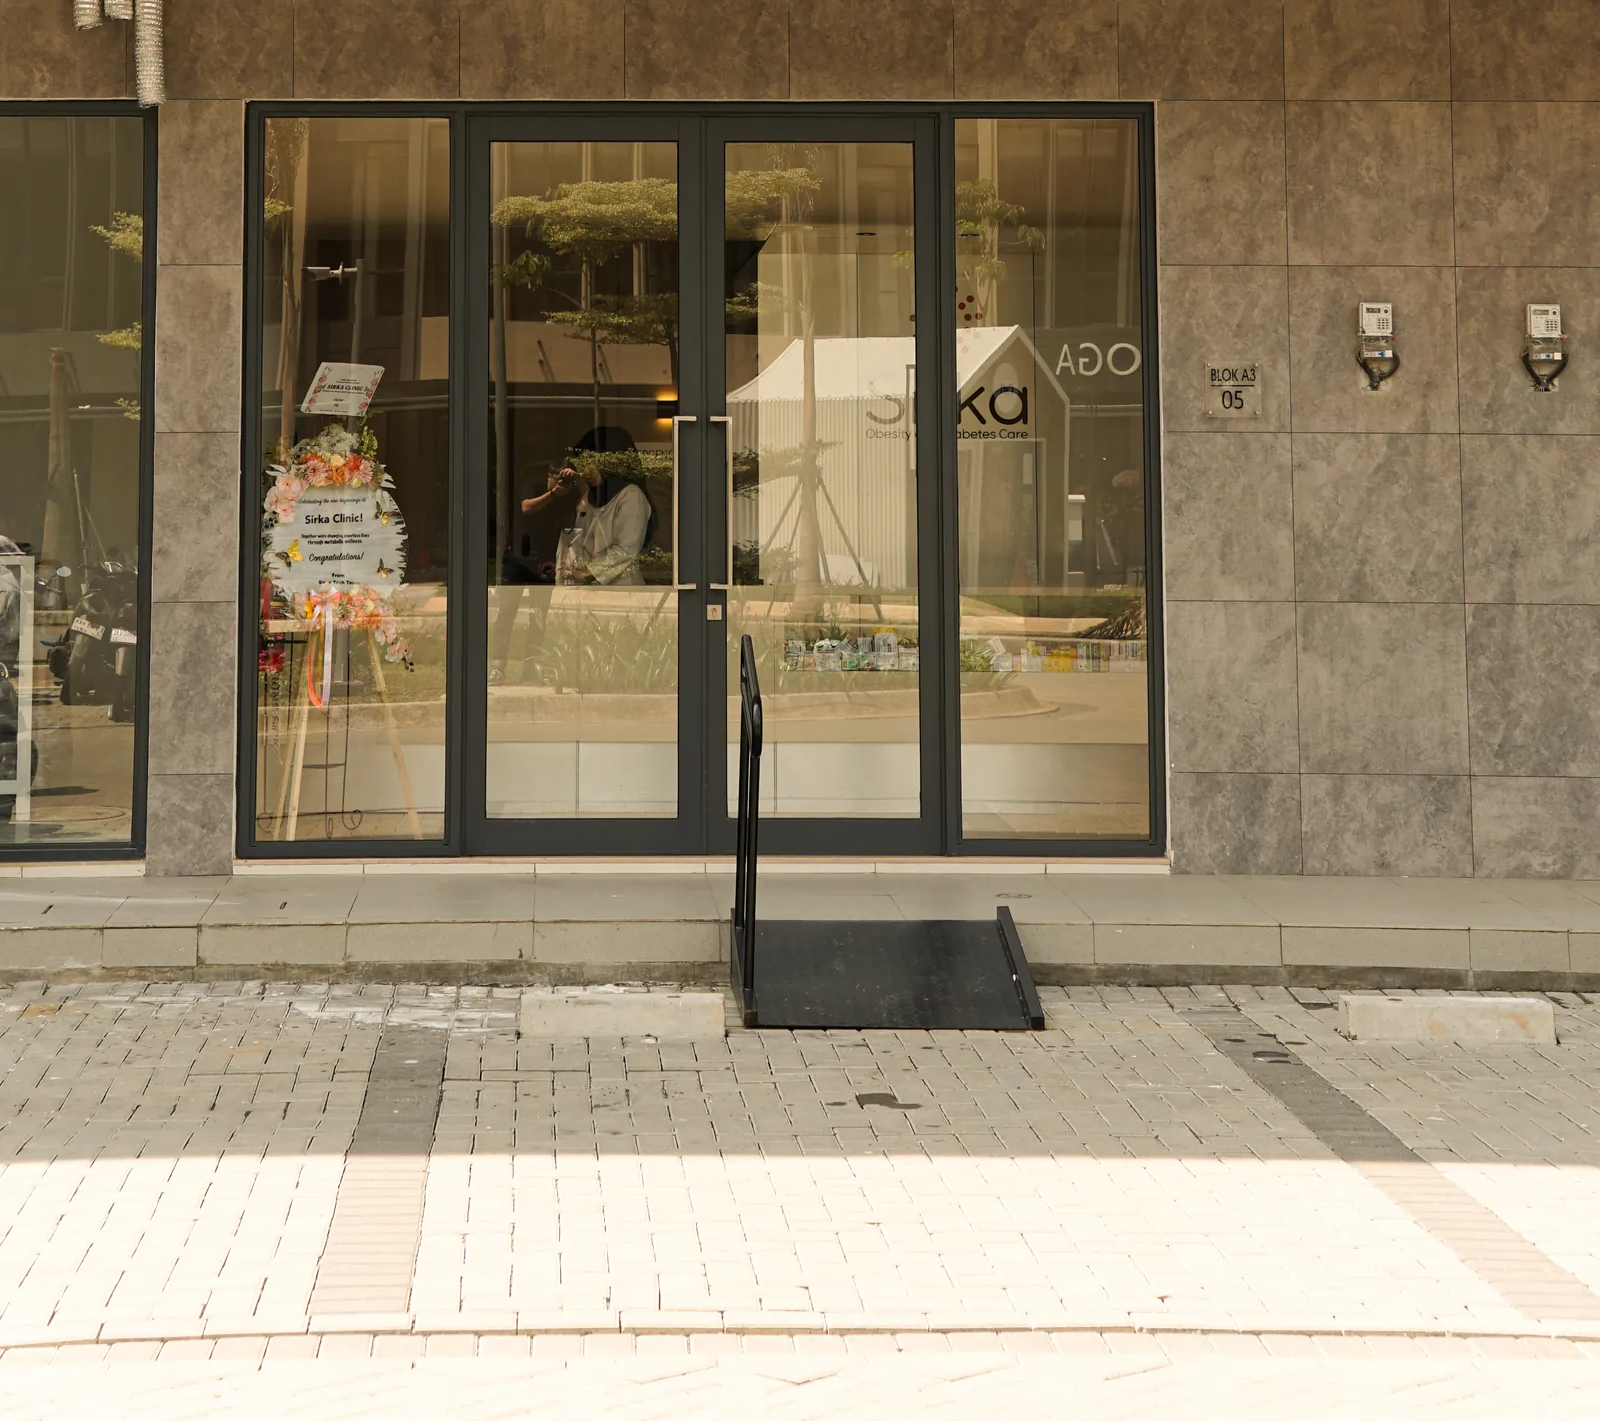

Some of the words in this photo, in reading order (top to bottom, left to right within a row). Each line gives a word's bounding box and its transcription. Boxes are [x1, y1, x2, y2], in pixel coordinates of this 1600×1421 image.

[1210, 368, 1239, 382] BLOK
[1241, 368, 1256, 382] A3
[866, 378, 1028, 425] Ska
[1222, 390, 1244, 410] 05
[866, 429, 912, 441] Obesity
[957, 429, 996, 439] abetes
[999, 429, 1029, 439] Care
[305, 514, 330, 524] Sirka
[332, 512, 363, 523] Clinic!
[309, 551, 364, 565] Congratulations!
